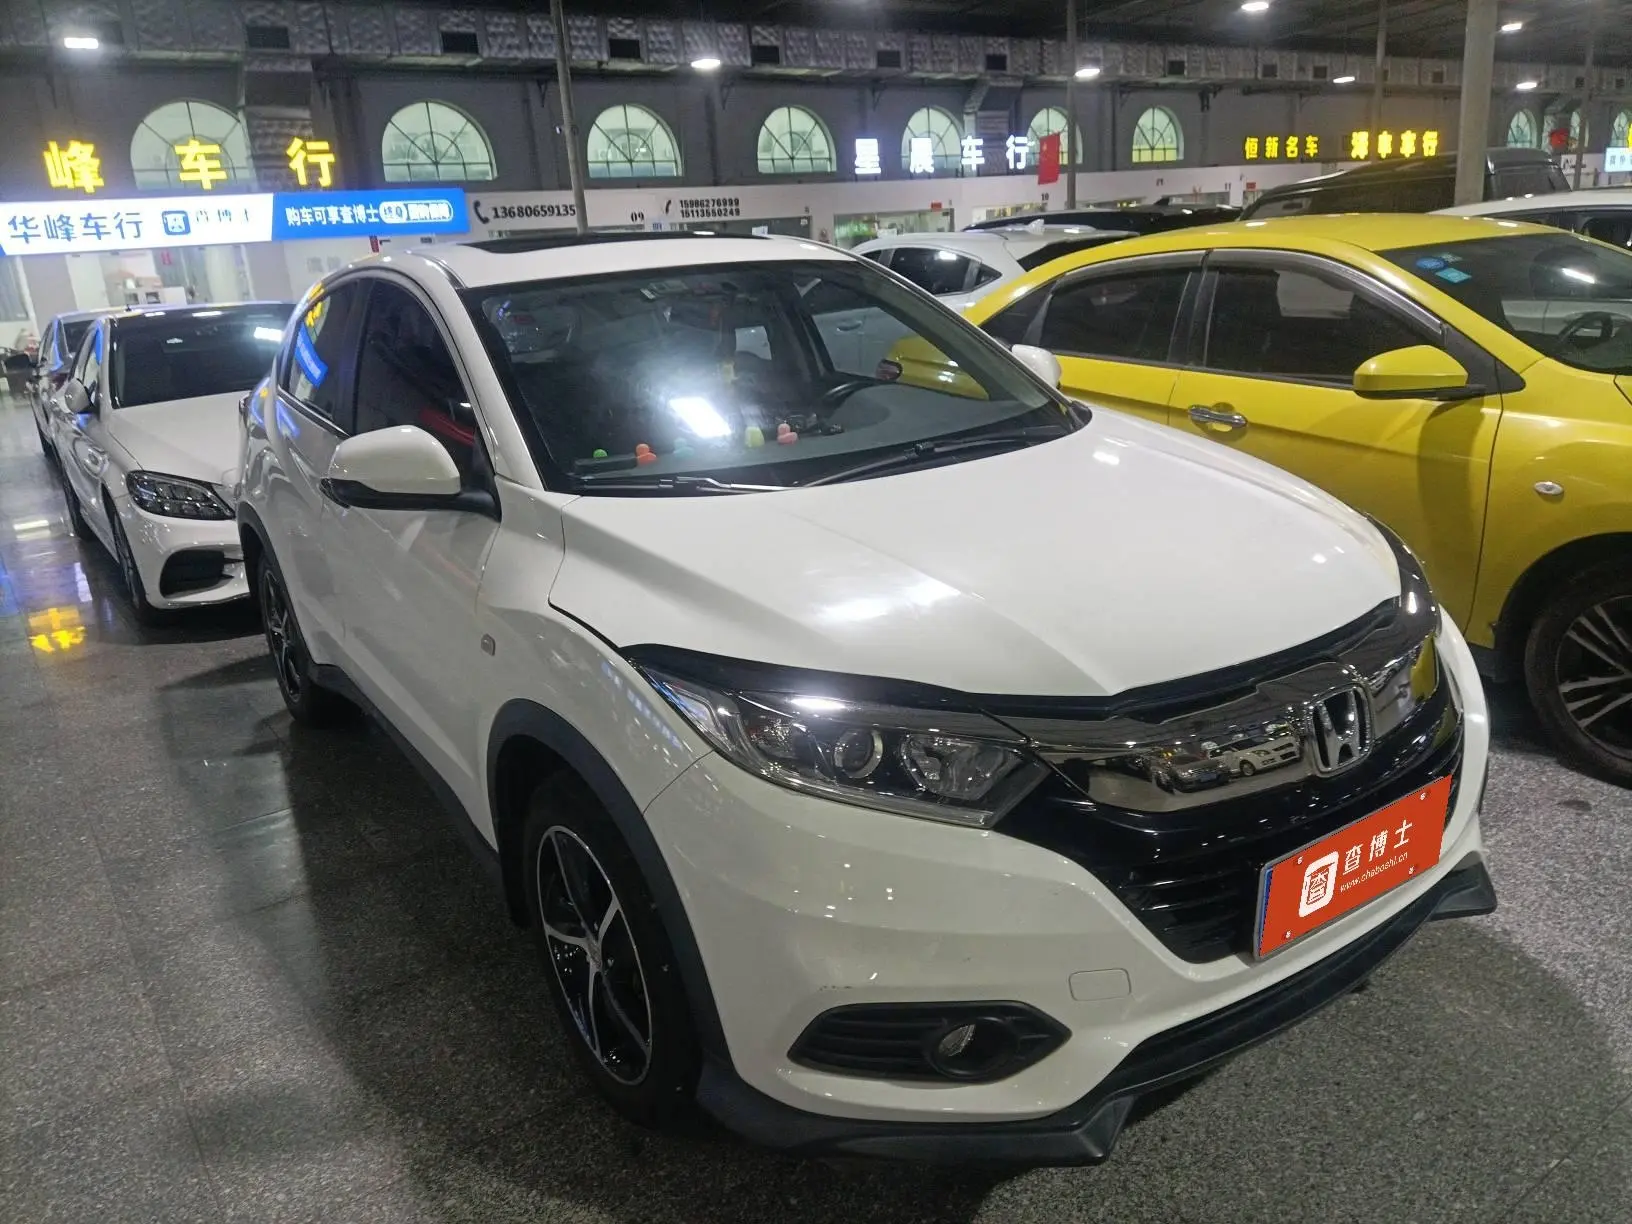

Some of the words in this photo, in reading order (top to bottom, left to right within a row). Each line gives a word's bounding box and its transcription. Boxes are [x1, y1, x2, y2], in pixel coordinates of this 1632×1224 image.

[492, 204, 577, 219] 13680659135
[630, 211, 645, 223] 09
[7, 211, 144, 245] 华峰车行
